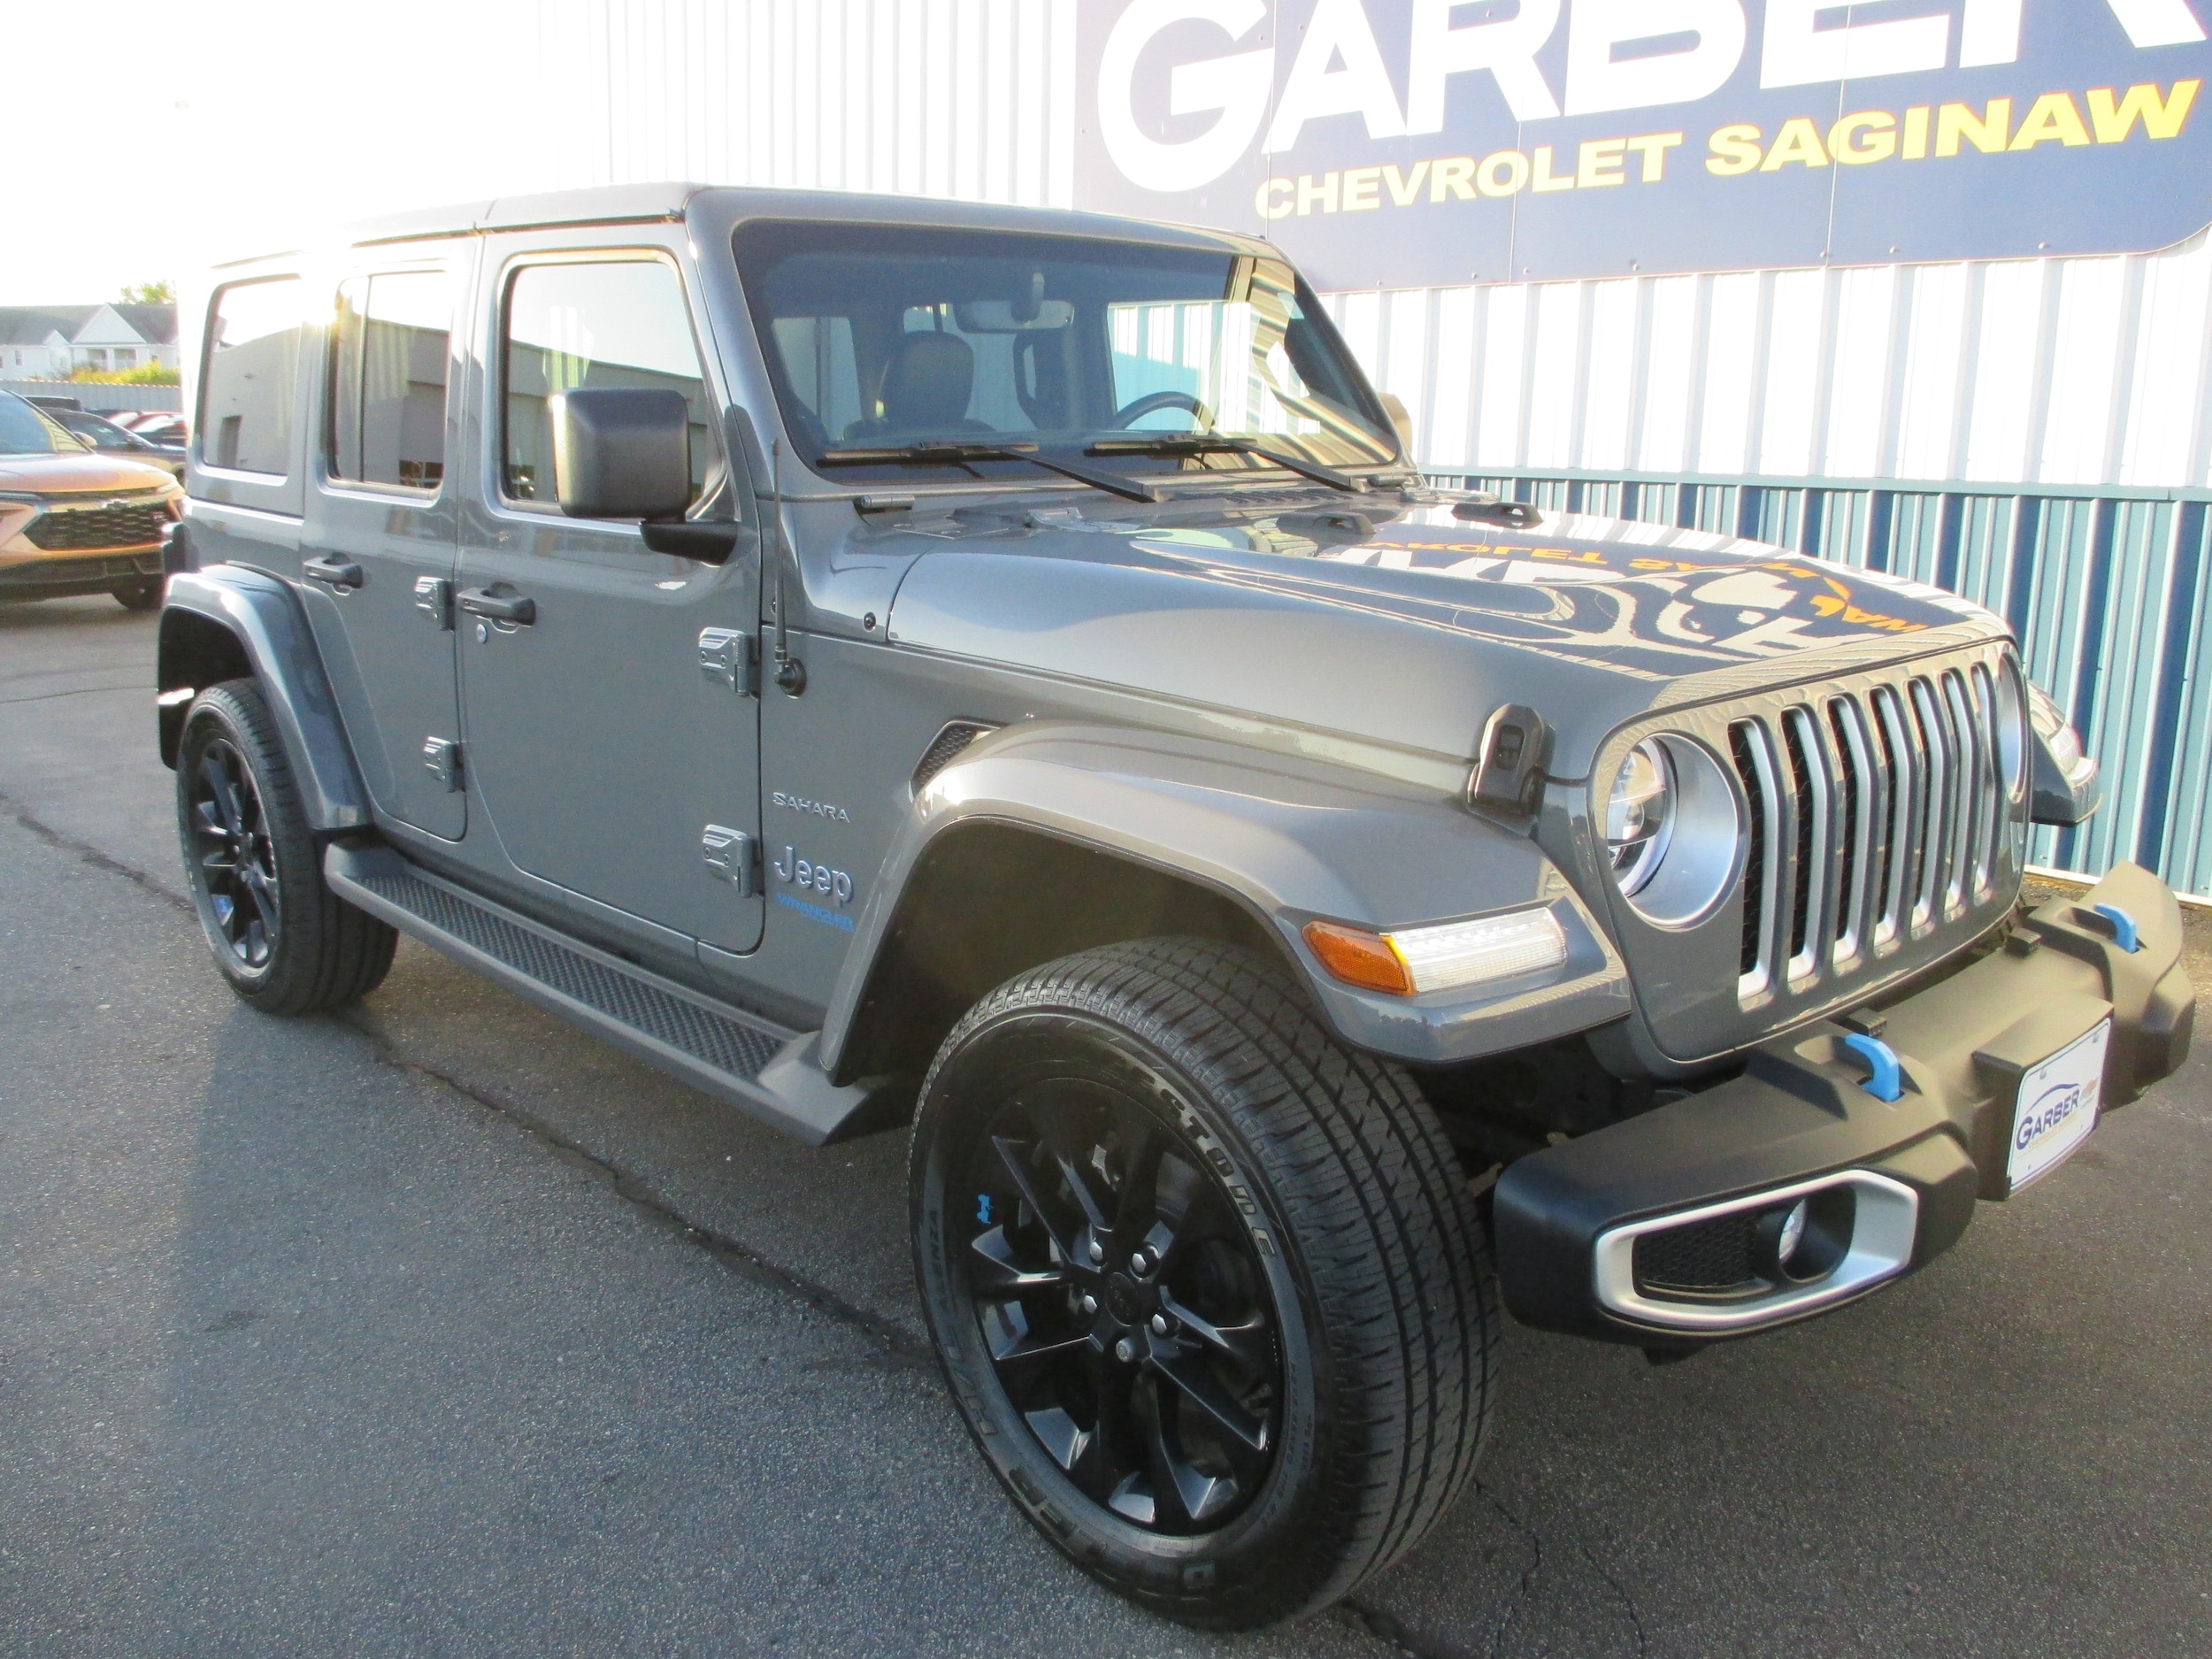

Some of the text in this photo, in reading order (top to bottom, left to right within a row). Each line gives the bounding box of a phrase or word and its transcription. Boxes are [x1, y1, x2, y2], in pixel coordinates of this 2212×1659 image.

[1255, 79, 2201, 219] CHEVROLET SAGINAW
[772, 792, 850, 824] SAHARA
[774, 845, 854, 908] Jeep
[2016, 1088, 2080, 1150] GARBER
